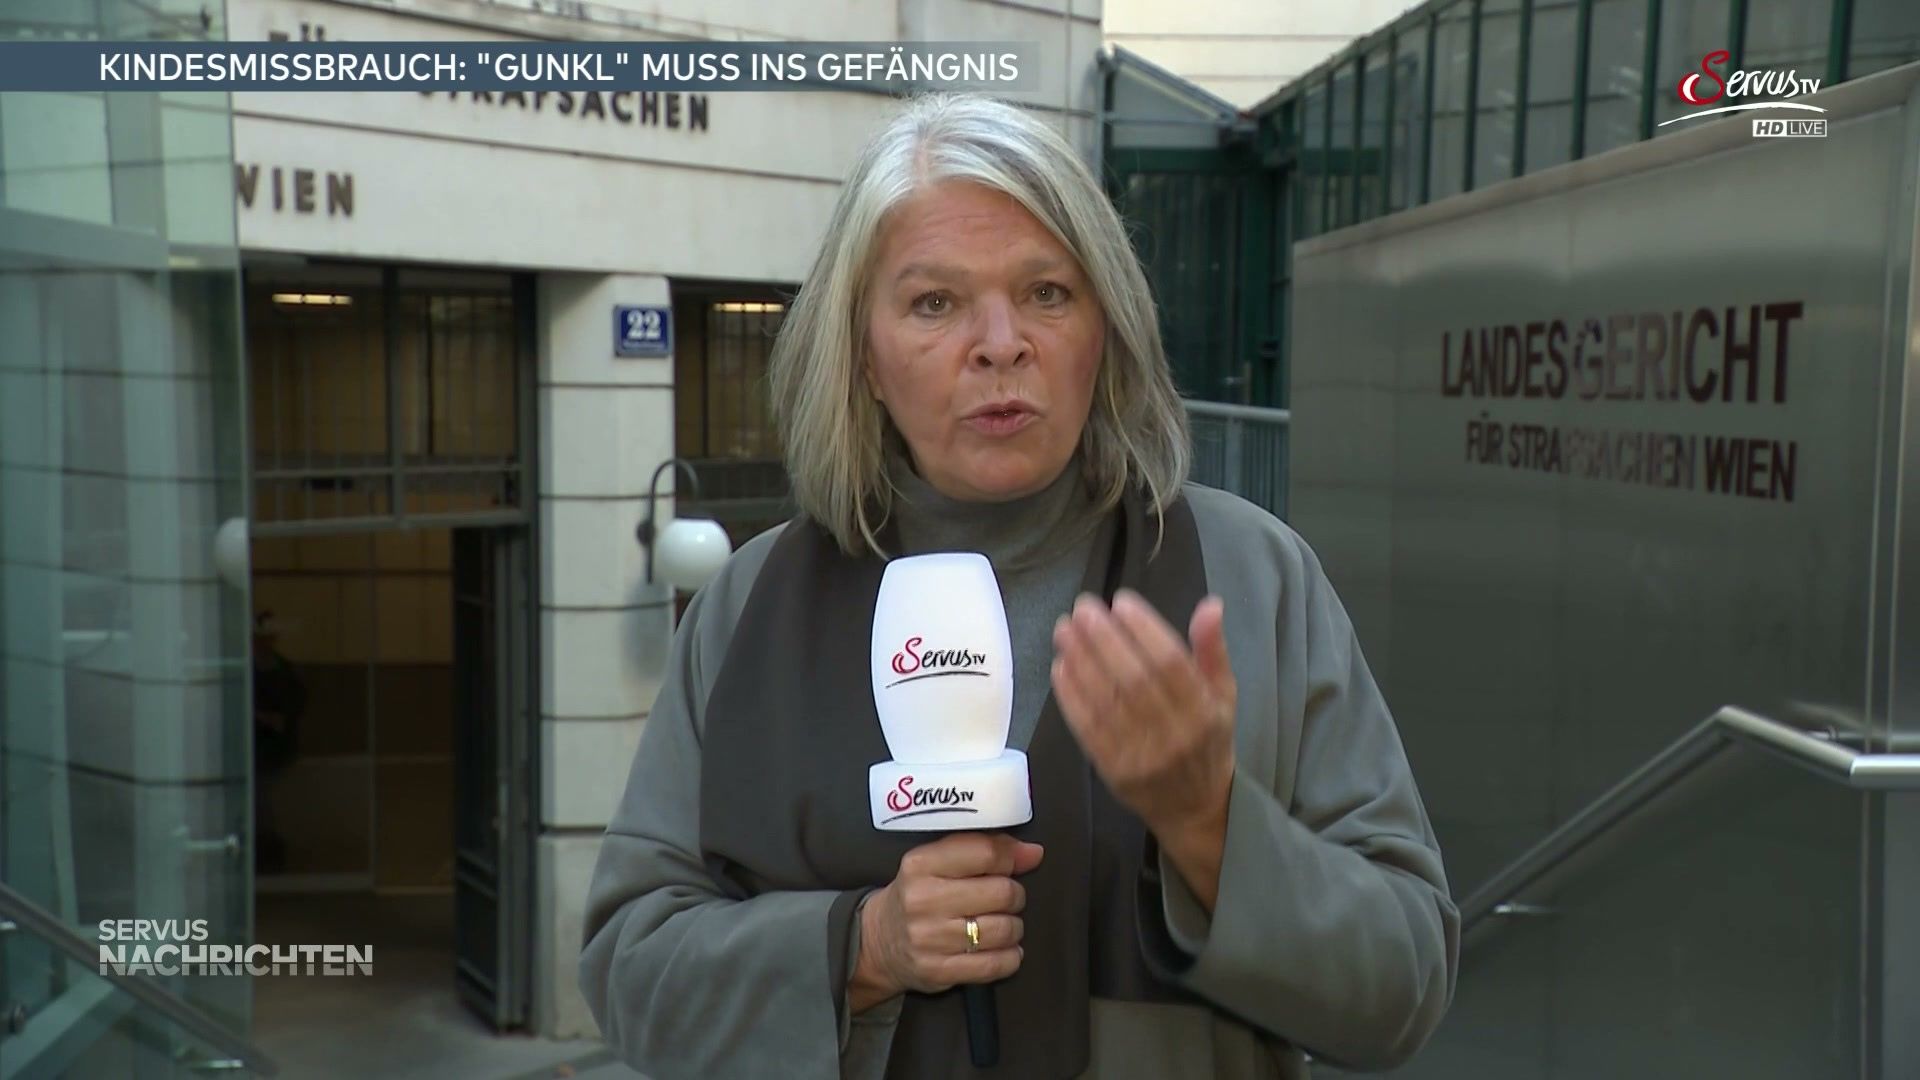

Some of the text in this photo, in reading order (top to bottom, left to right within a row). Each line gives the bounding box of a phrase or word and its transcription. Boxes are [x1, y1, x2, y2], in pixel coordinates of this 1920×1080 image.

[418, 91, 709, 131] AFSACHEN
[626, 309, 661, 339] 22
[1442, 302, 1803, 404] LANDESGERICHT
[1465, 410, 1504, 465] FÜR
[1704, 435, 1797, 503] WIEN
